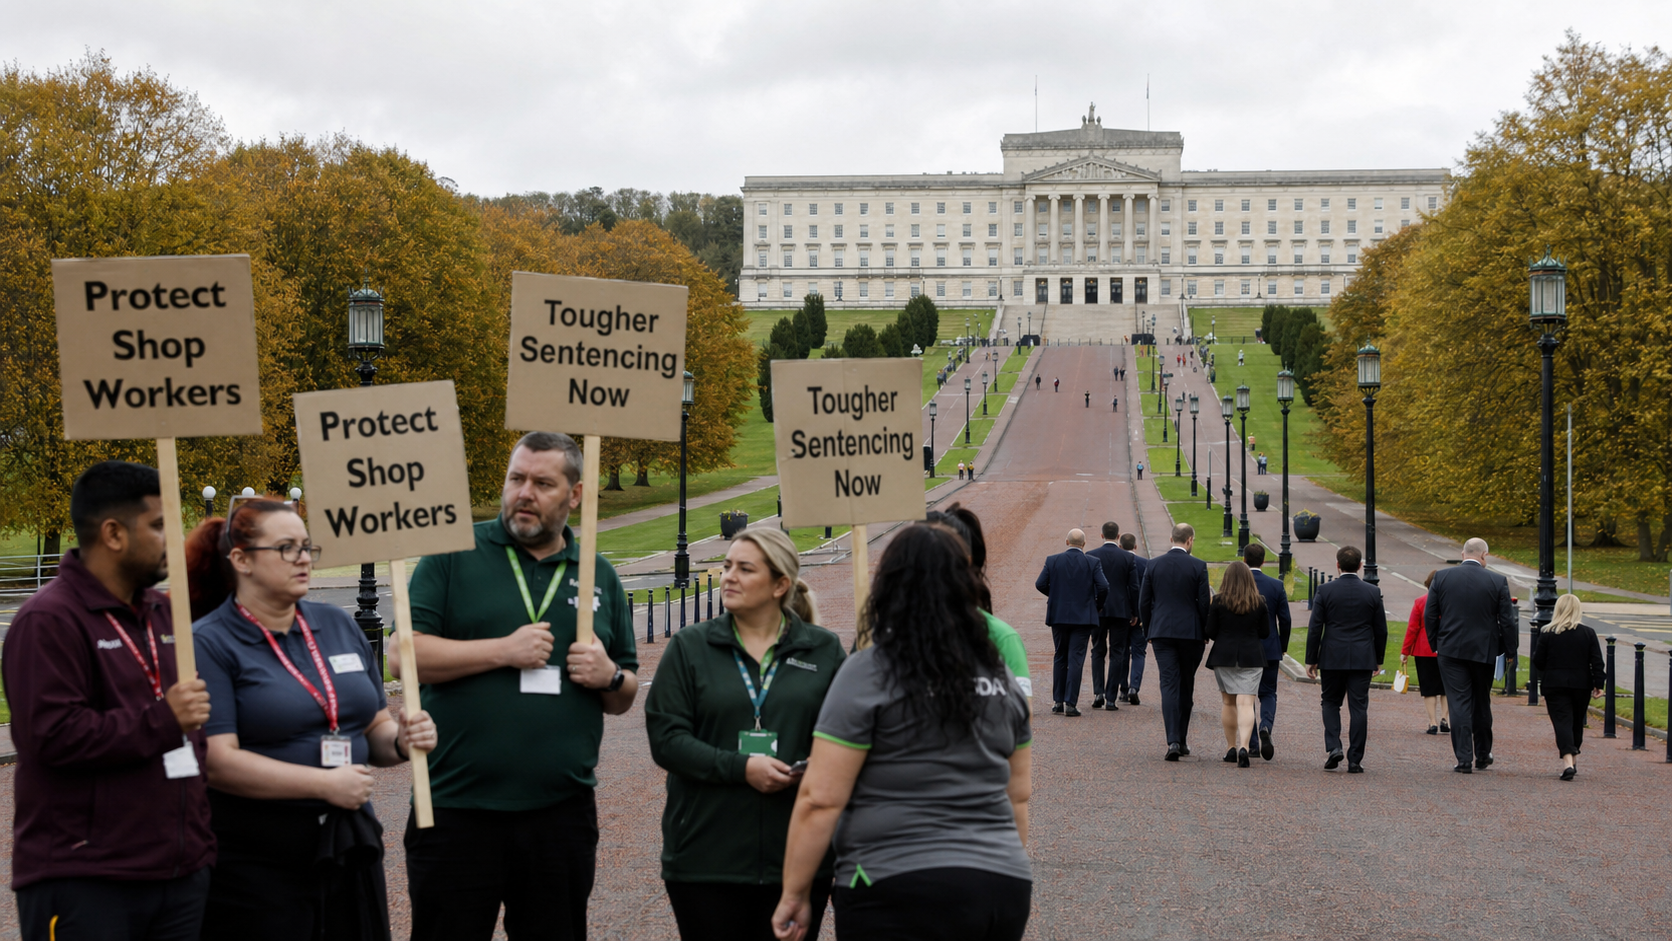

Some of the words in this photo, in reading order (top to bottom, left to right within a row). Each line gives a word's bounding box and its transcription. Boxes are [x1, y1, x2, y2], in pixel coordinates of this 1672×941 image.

[84, 281, 226, 311] Protect
[545, 300, 659, 335] Tougher
[112, 329, 206, 368] Shop
[520, 335, 677, 379] Sentencing
[83, 377, 241, 409] Workers
[569, 378, 629, 407] Now
[807, 385, 897, 420] Tougher
[320, 407, 438, 441] Protect
[792, 428, 913, 460] Sentencing
[347, 458, 424, 491] Shop
[835, 470, 881, 497] Now
[325, 502, 456, 537] Workers
[973, 677, 1007, 697] DA
